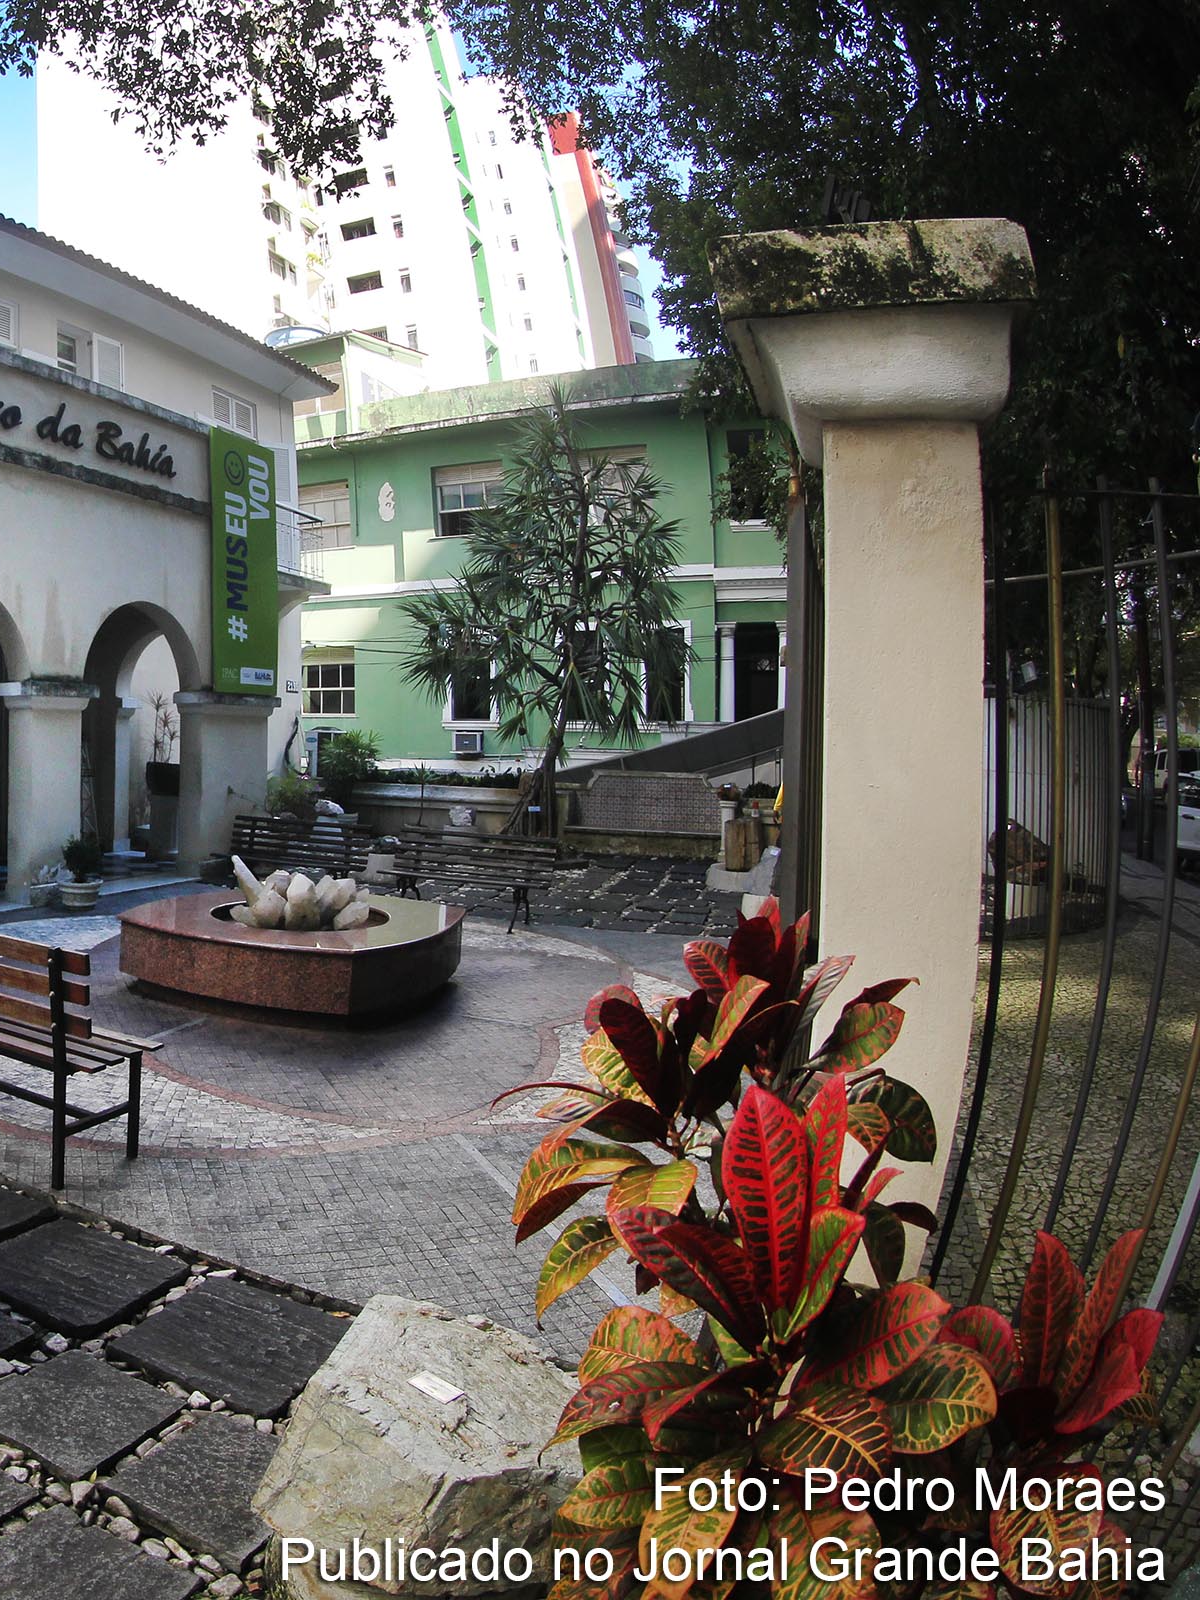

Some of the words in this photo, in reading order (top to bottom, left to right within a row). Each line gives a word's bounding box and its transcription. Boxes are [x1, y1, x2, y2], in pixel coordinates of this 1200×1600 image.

[36, 402, 84, 450] da
[95, 420, 177, 479] Bahia
[248, 455, 270, 520] VOU
